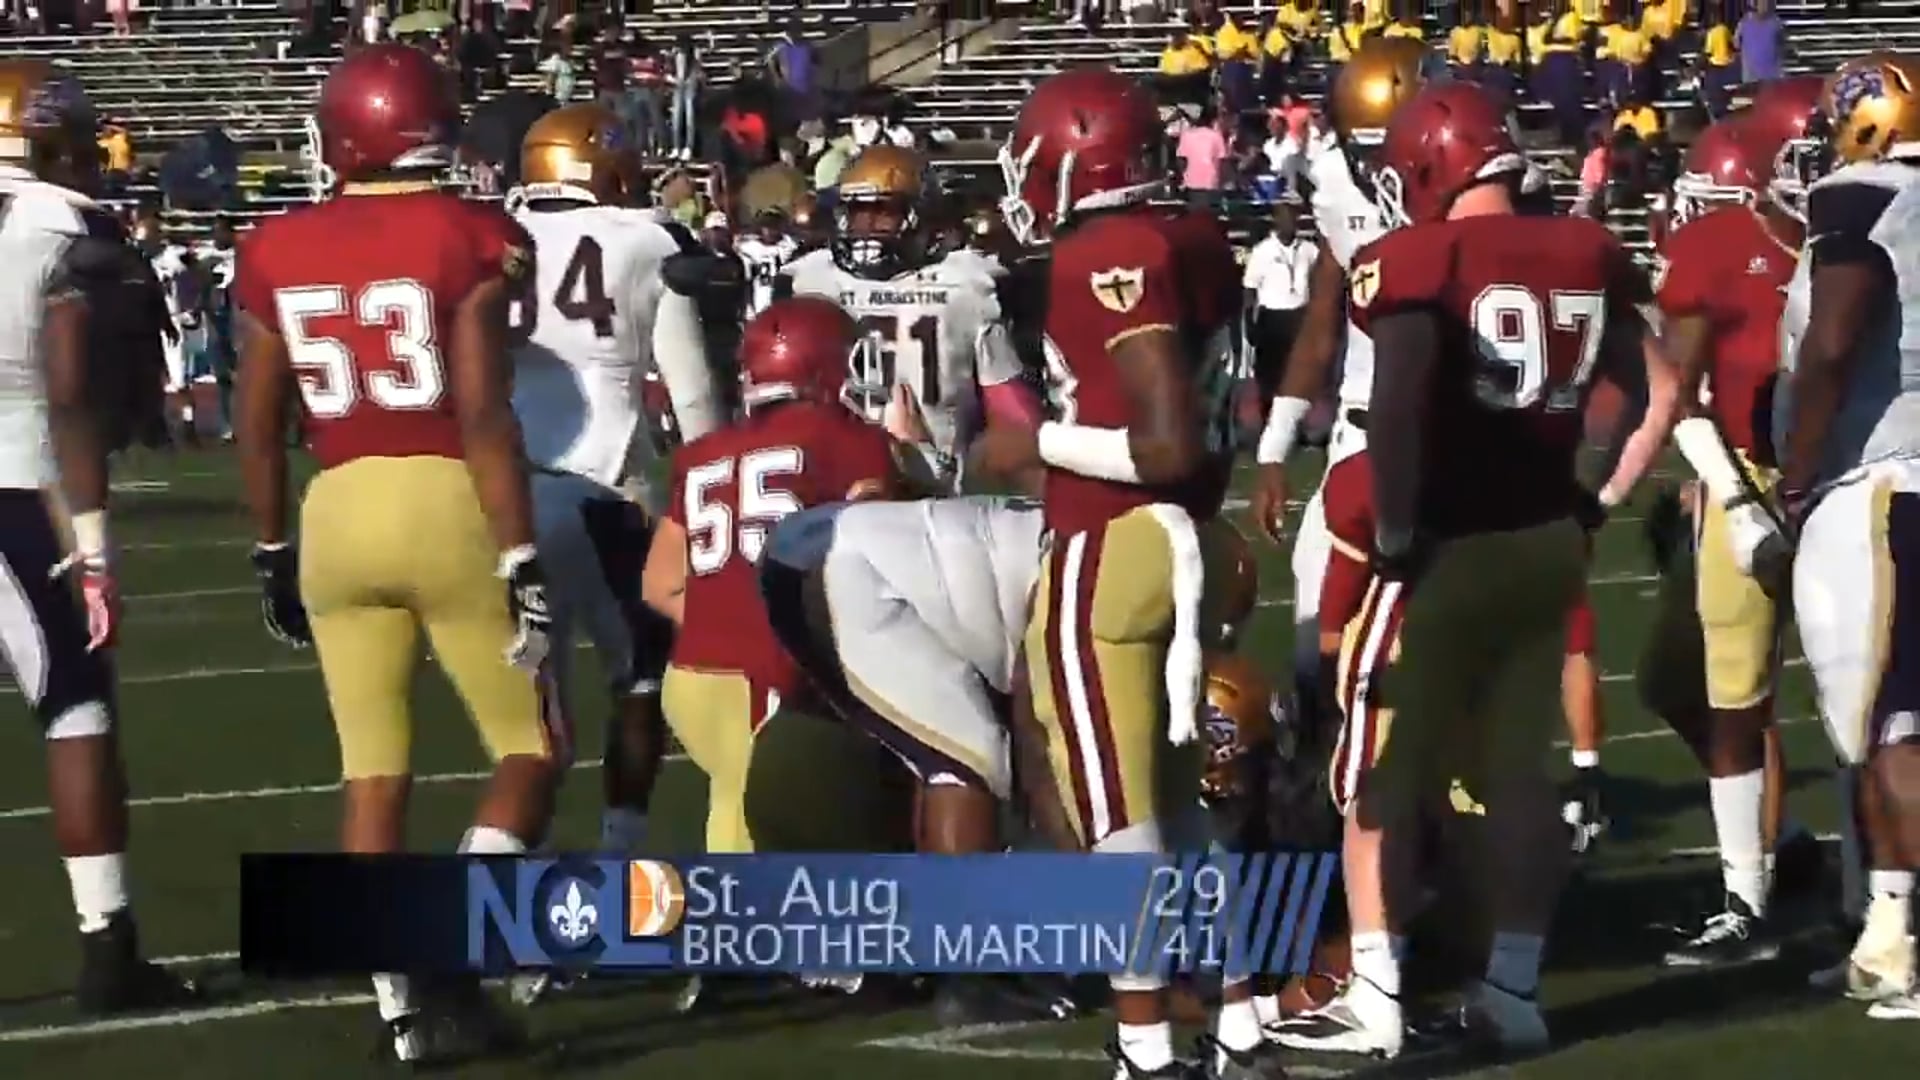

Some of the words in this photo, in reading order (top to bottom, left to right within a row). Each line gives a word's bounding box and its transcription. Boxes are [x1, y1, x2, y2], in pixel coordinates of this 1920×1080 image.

[273, 278, 444, 418] 53
[1469, 283, 1605, 413] 97
[684, 445, 803, 577] 55
